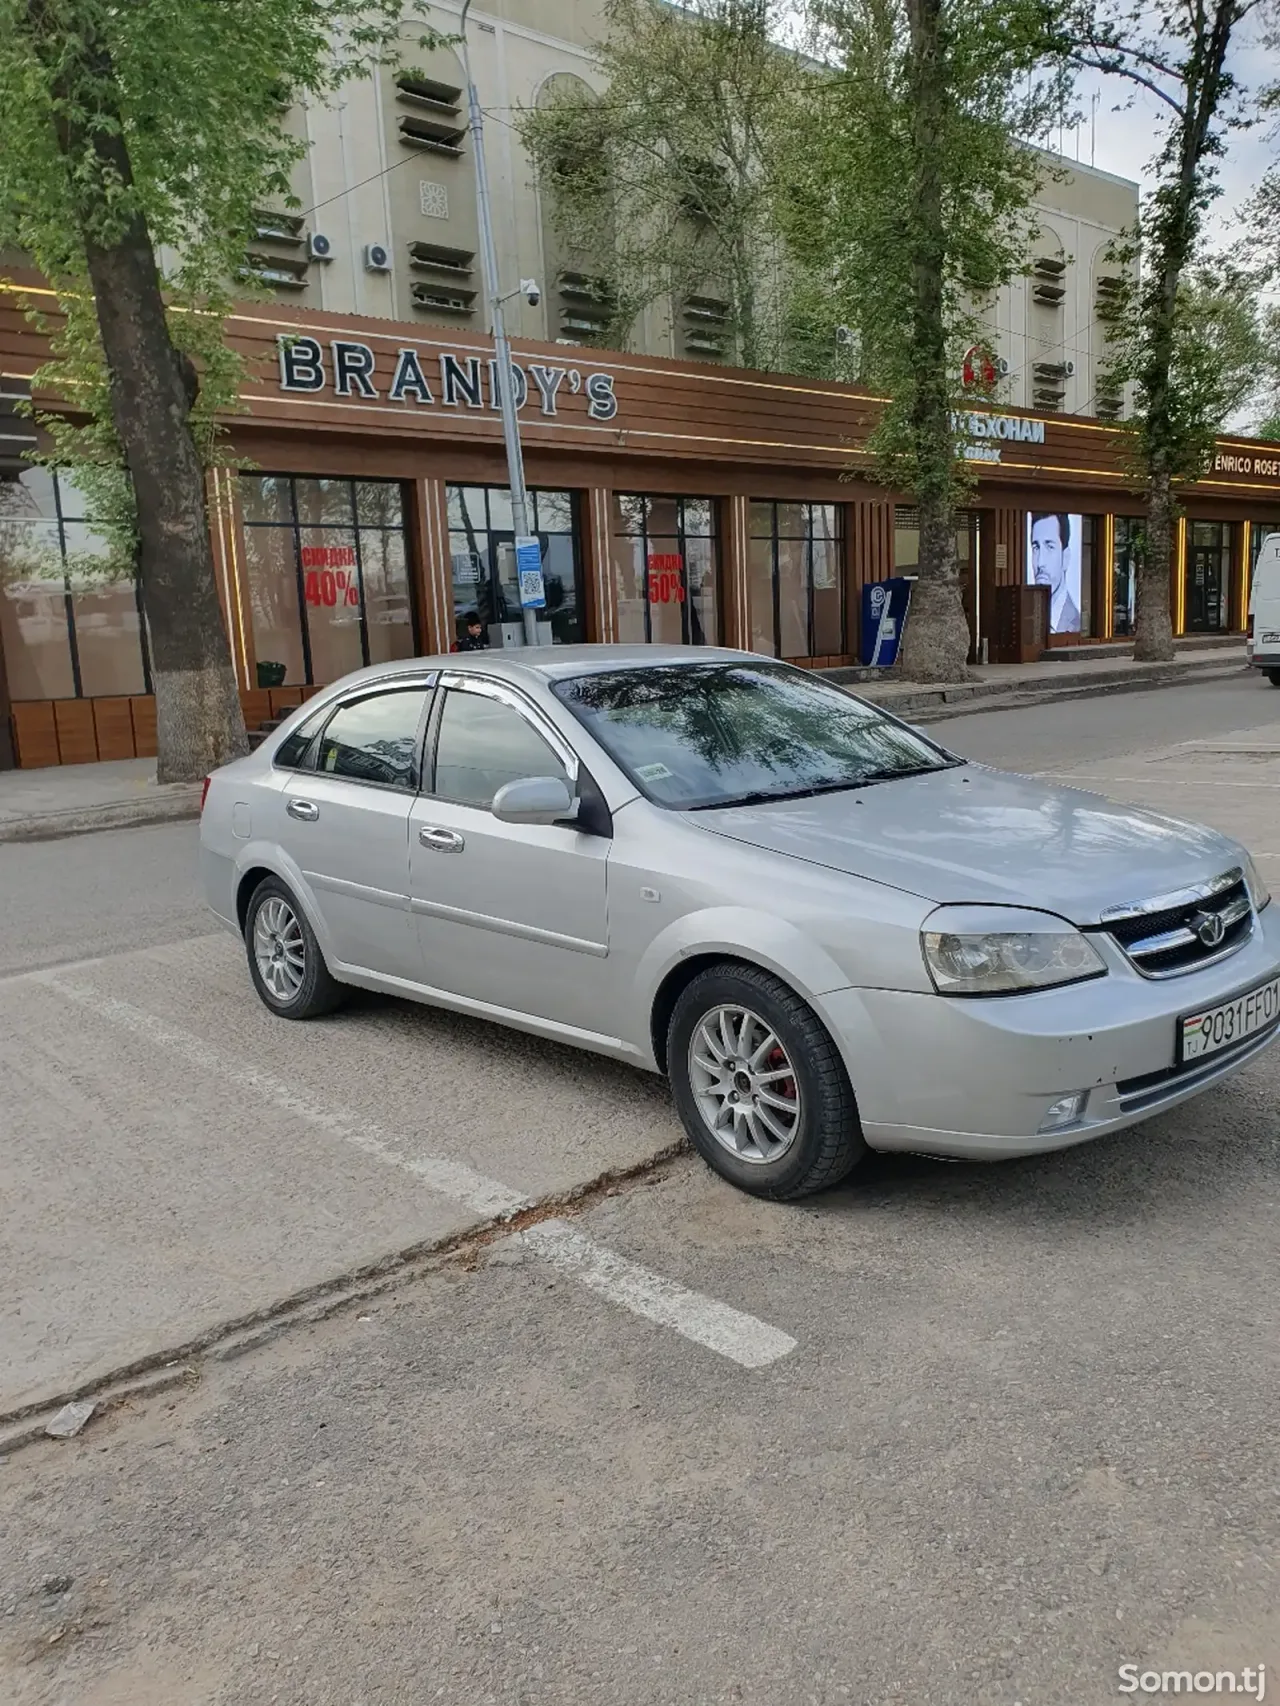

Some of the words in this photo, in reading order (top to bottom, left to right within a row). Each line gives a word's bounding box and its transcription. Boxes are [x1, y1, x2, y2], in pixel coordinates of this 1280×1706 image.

[276, 333, 617, 421] BRANDY'S
[1214, 455, 1252, 473] ENRICO
[305, 570, 359, 607] 40%
[648, 573, 685, 604] 50%
[1201, 981, 1279, 1051] 9031FF01
[1187, 1040, 1198, 1055] TJ
